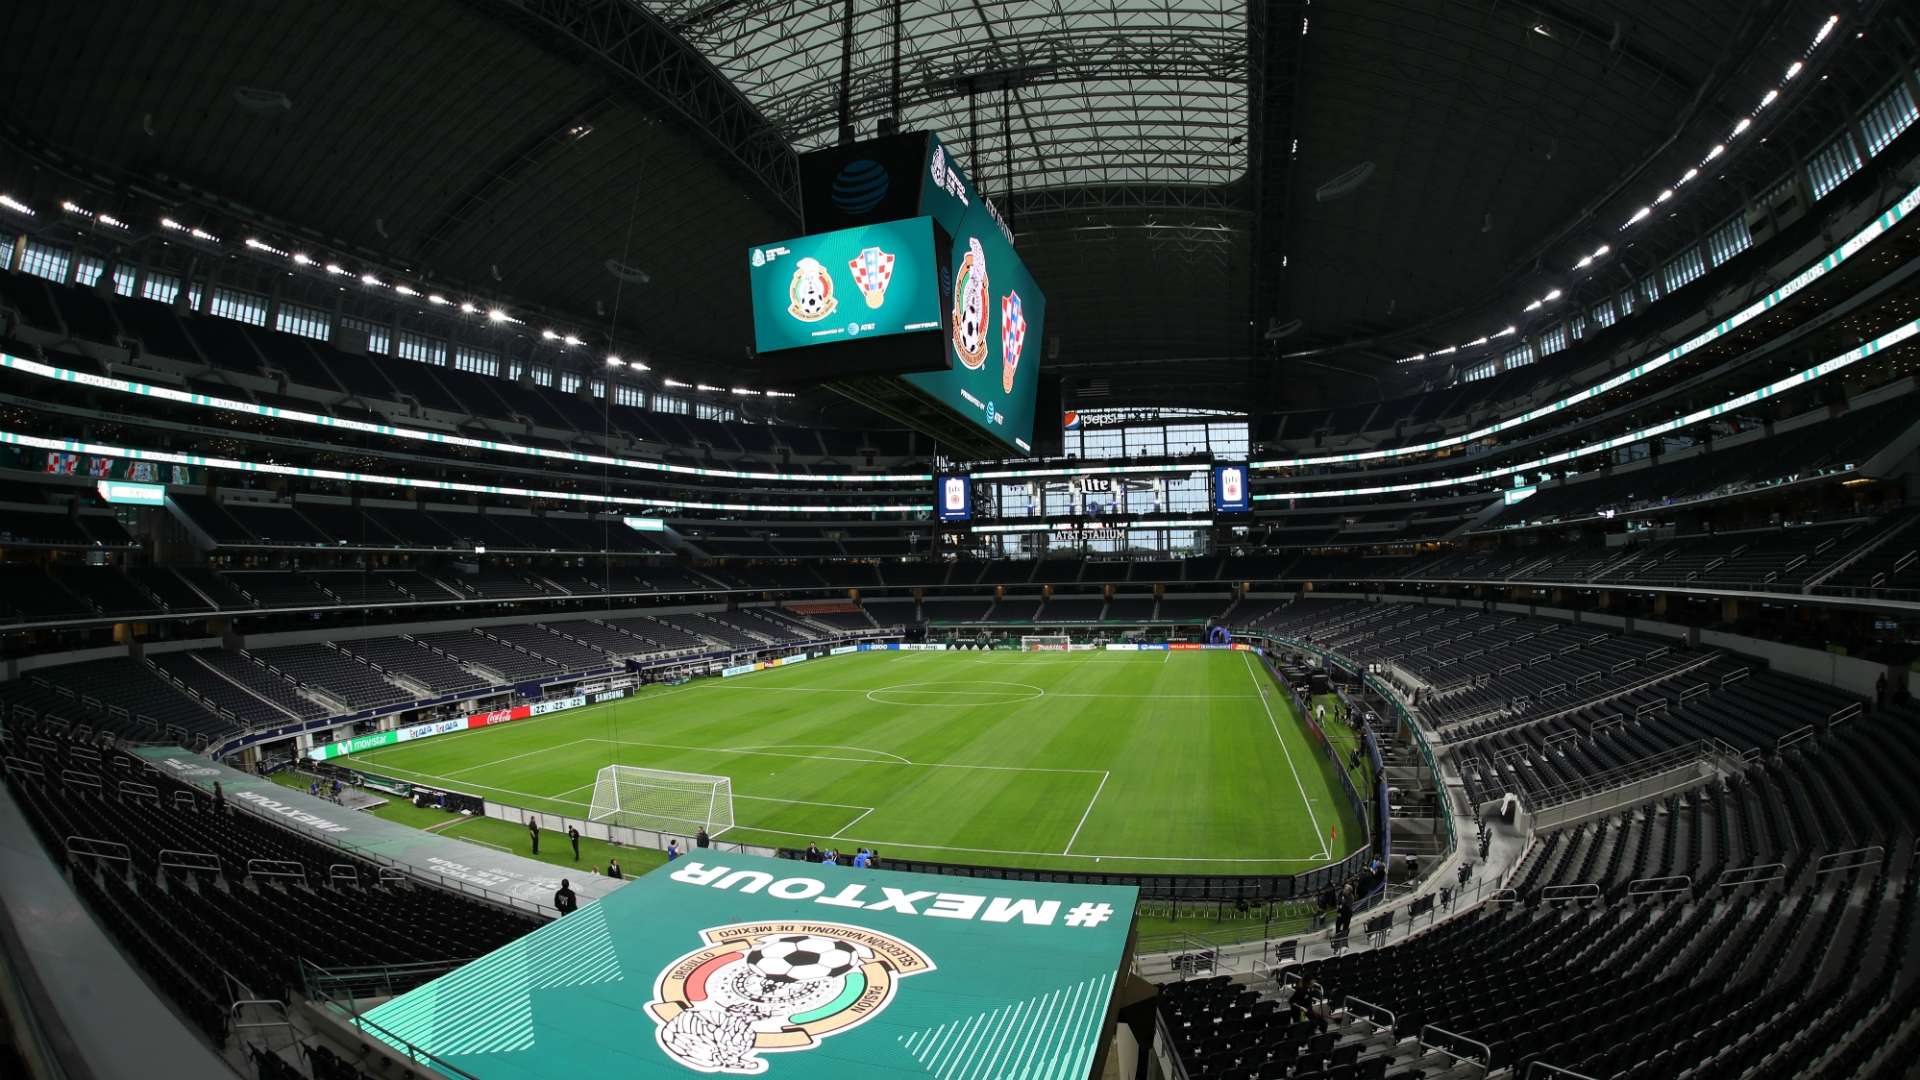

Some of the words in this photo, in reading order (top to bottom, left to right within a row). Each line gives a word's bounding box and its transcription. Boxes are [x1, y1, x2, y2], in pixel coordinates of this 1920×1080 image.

[1083, 413, 1116, 427] pepsi
[1055, 530, 1079, 540] AT&T
[1081, 529, 1125, 540] STADIUM
[595, 689, 624, 703] SAMSUNG
[486, 709, 512, 724] Coca-Cola
[353, 734, 388, 751] movistar
[234, 791, 350, 832] #MEXTOUR
[669, 861, 1115, 928] #MEXTOUR
[774, 924, 795, 933] DE
[799, 924, 867, 947] NACIONAL
[671, 952, 716, 981] ORGULLO
[850, 985, 884, 1014] PASIÓN
